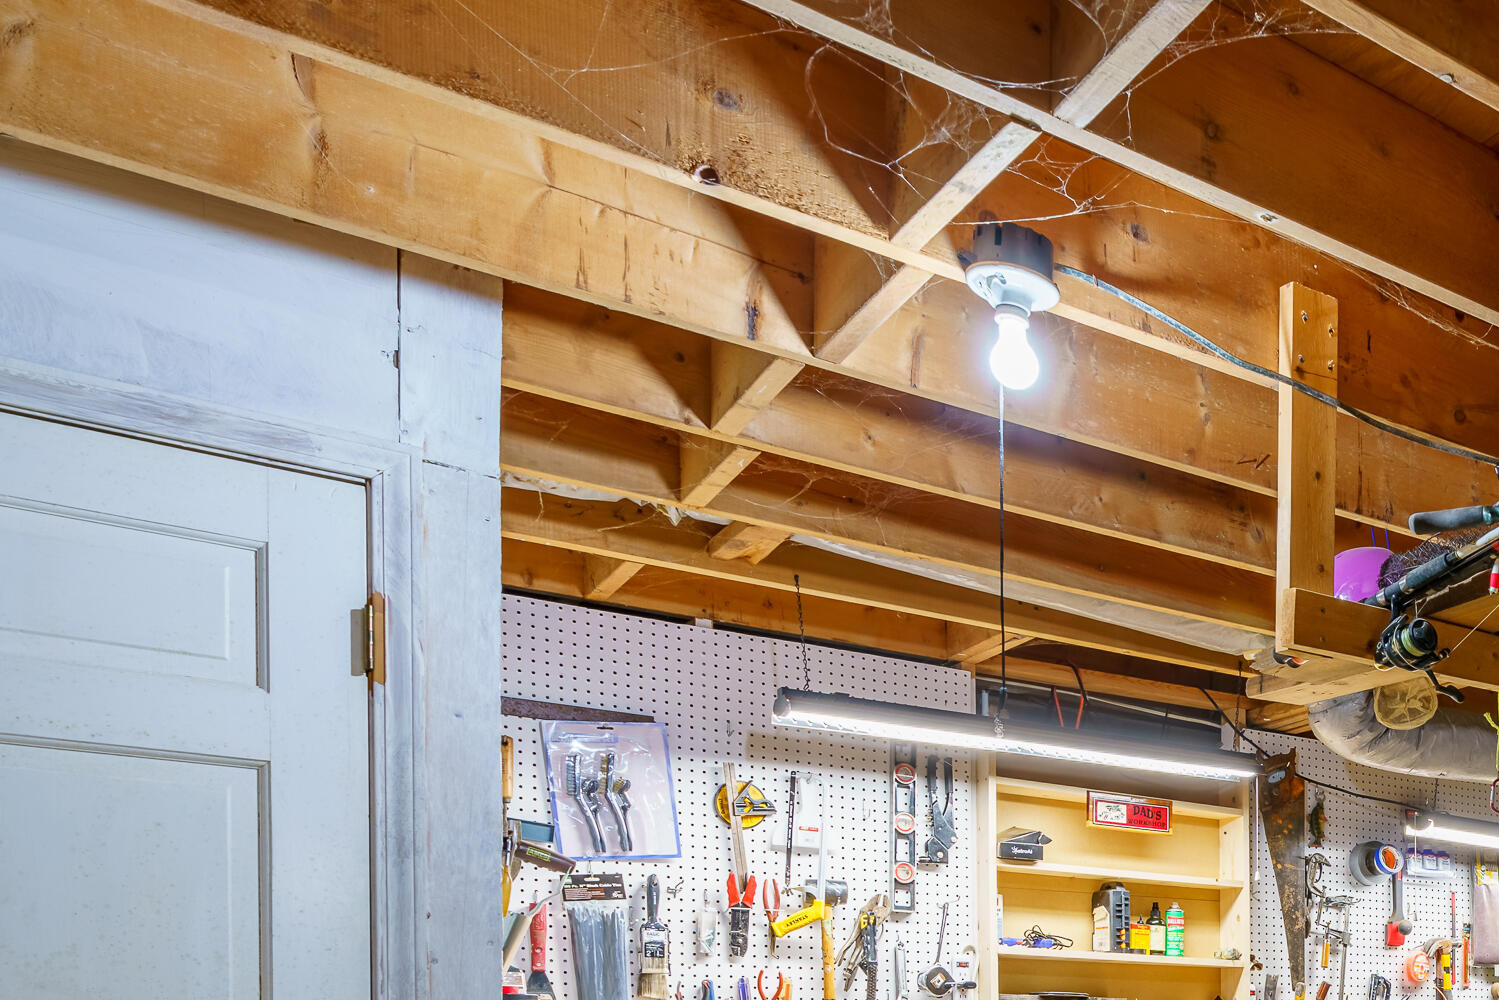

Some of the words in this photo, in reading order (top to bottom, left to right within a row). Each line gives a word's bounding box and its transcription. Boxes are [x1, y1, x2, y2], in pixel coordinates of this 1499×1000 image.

[1133, 805, 1162, 821] DAD'S
[1127, 818, 1167, 828] WORKSHOP
[785, 914, 809, 928] STANLEY
